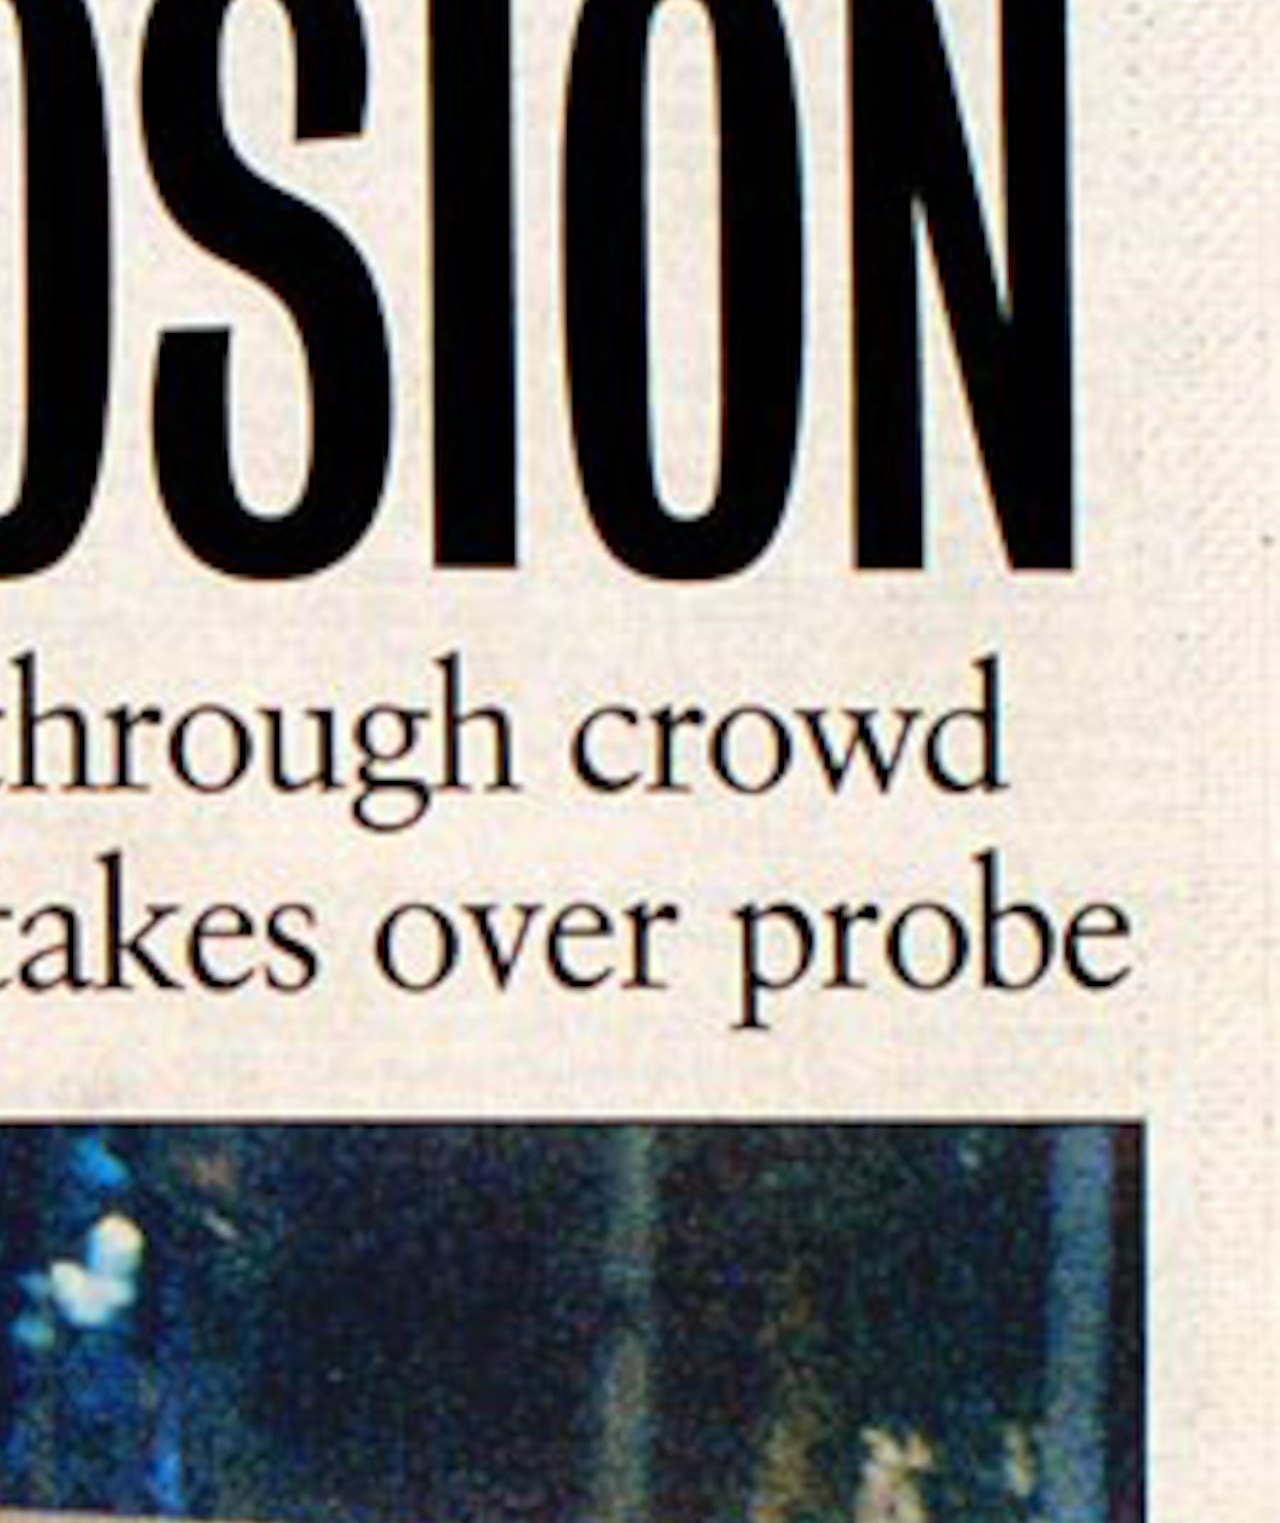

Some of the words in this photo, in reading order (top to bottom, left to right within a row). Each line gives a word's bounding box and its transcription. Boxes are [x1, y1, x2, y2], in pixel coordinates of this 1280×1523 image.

[571, 655, 1000, 794] crowd
[375, 903, 678, 991] over
[734, 849, 1129, 1030] probe
